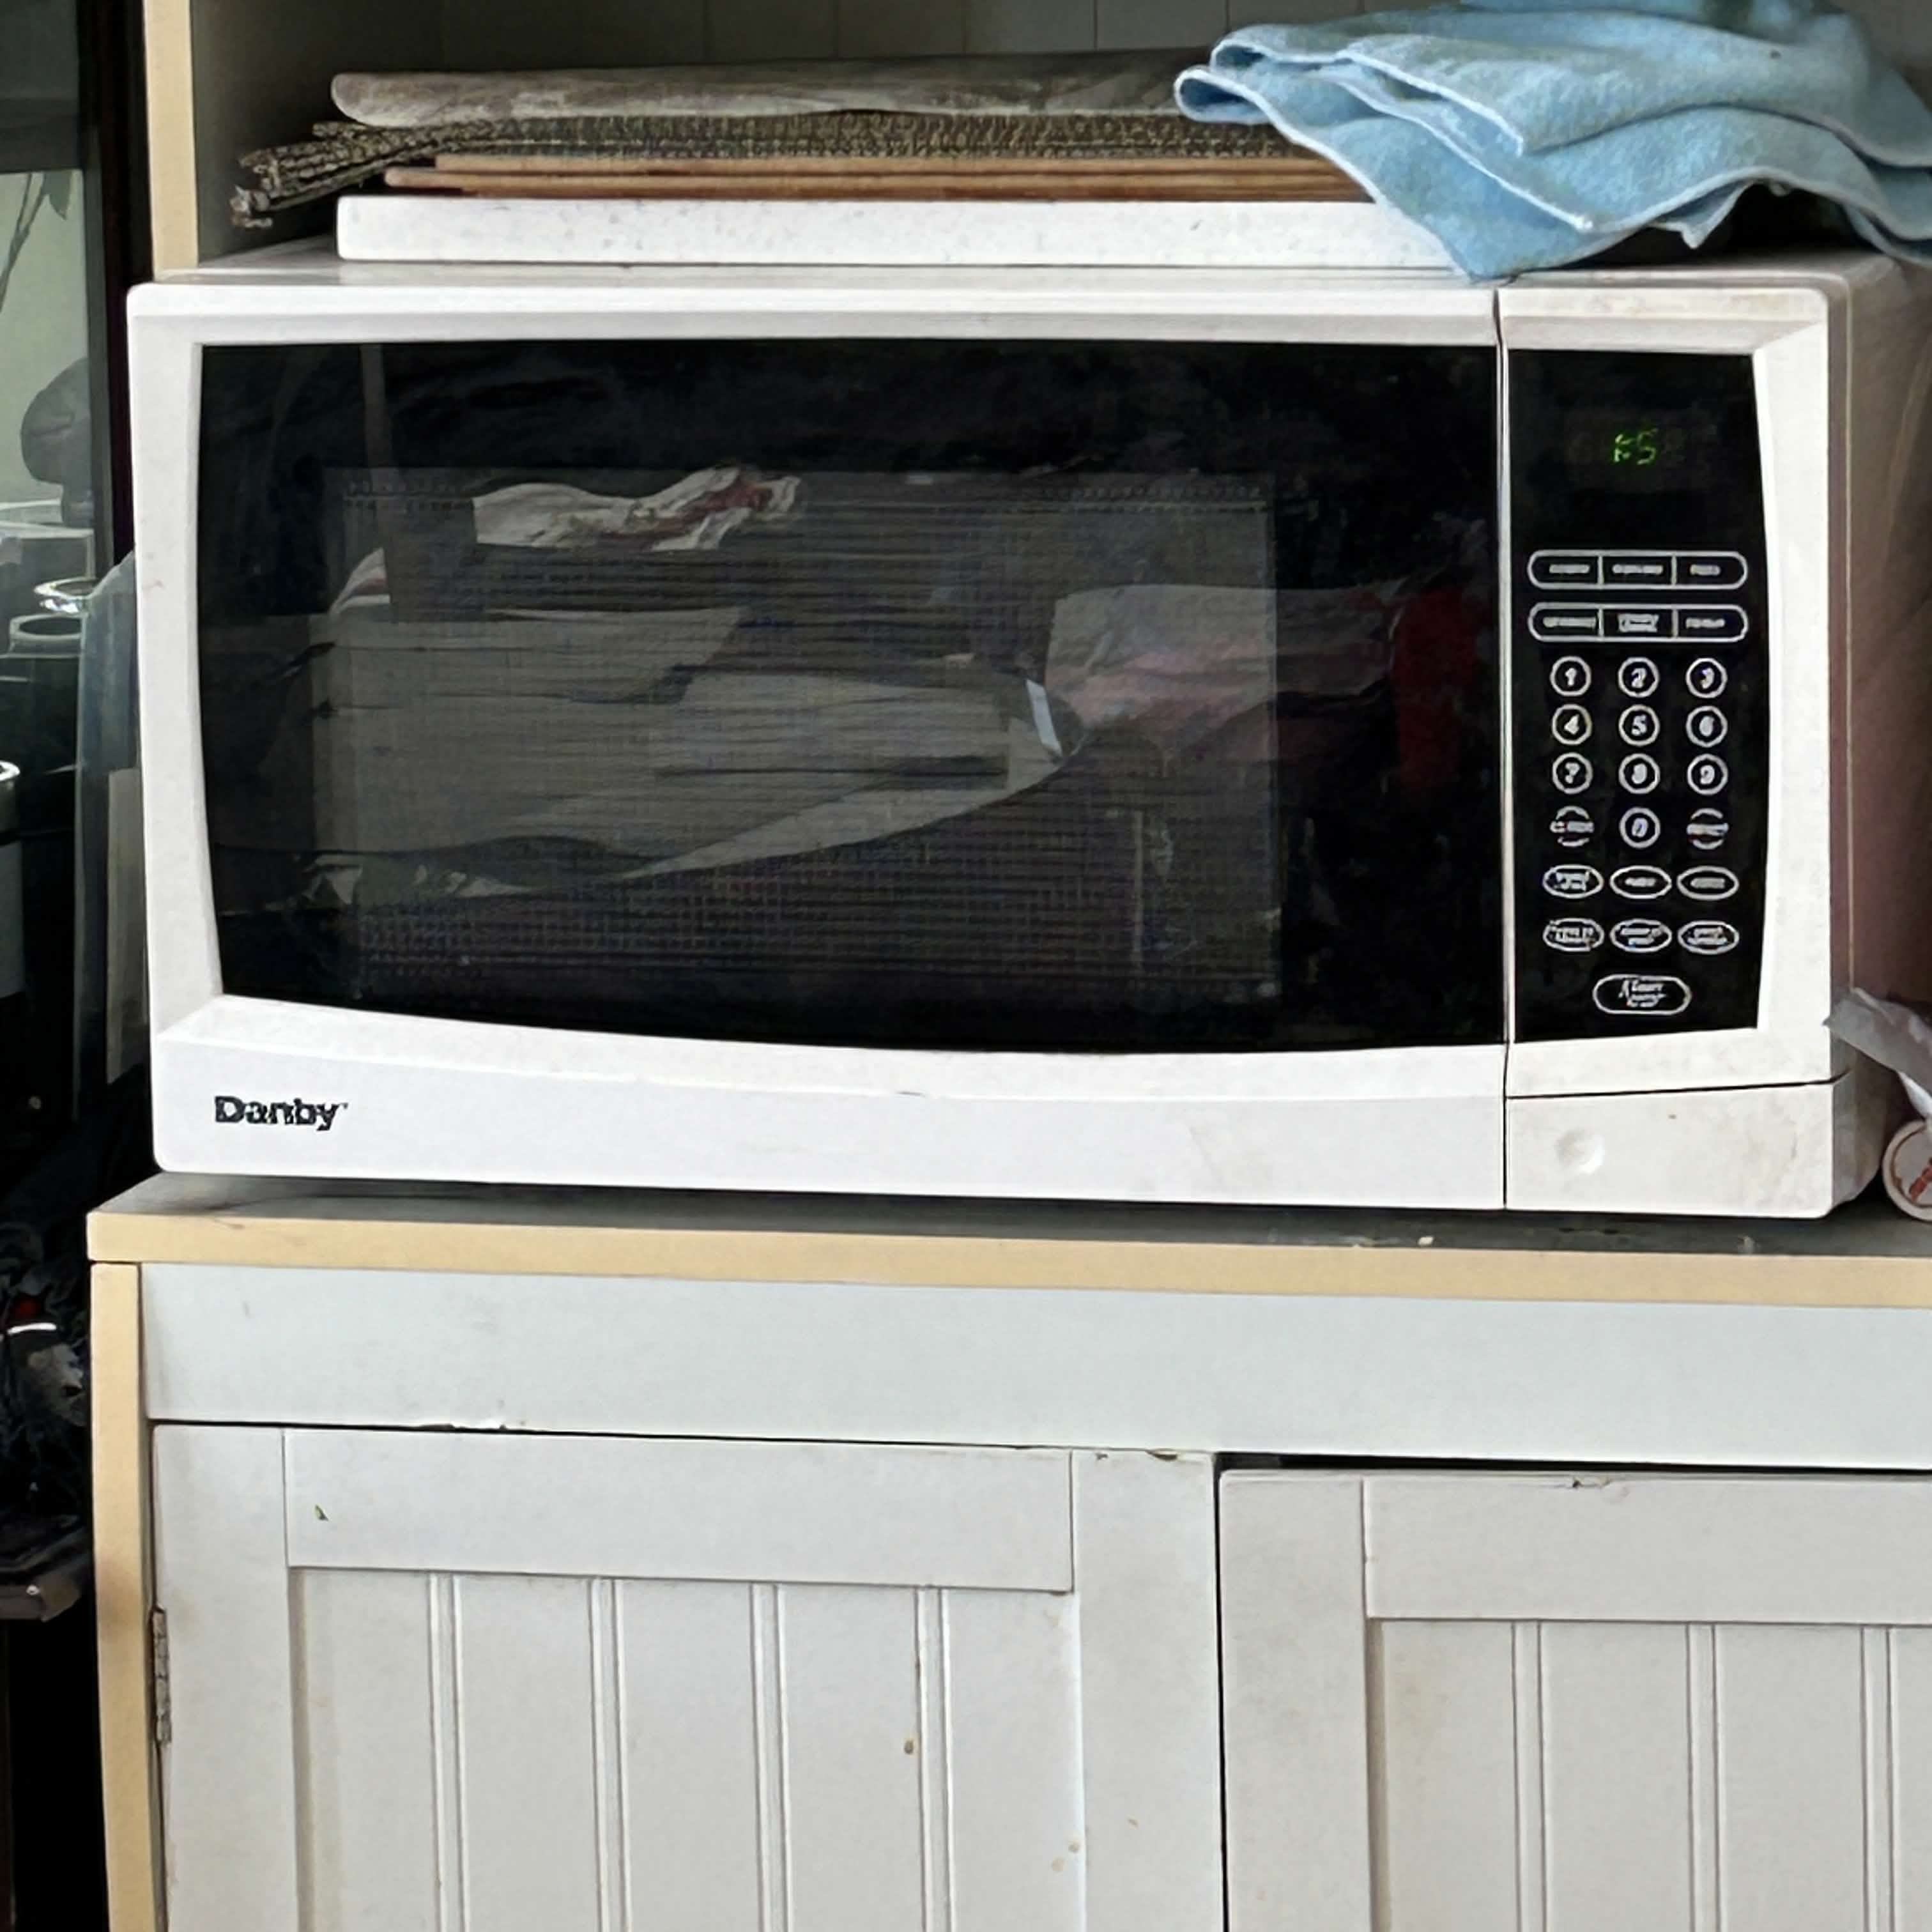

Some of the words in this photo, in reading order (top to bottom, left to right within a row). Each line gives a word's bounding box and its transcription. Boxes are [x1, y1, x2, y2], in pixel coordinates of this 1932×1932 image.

[1565, 668, 1576, 686] 1
[1631, 668, 1646, 688] 2
[1564, 714, 1579, 734] 4
[1632, 714, 1646, 735] 5
[1700, 765, 1715, 784] 9
[215, 1096, 339, 1131] Danby
